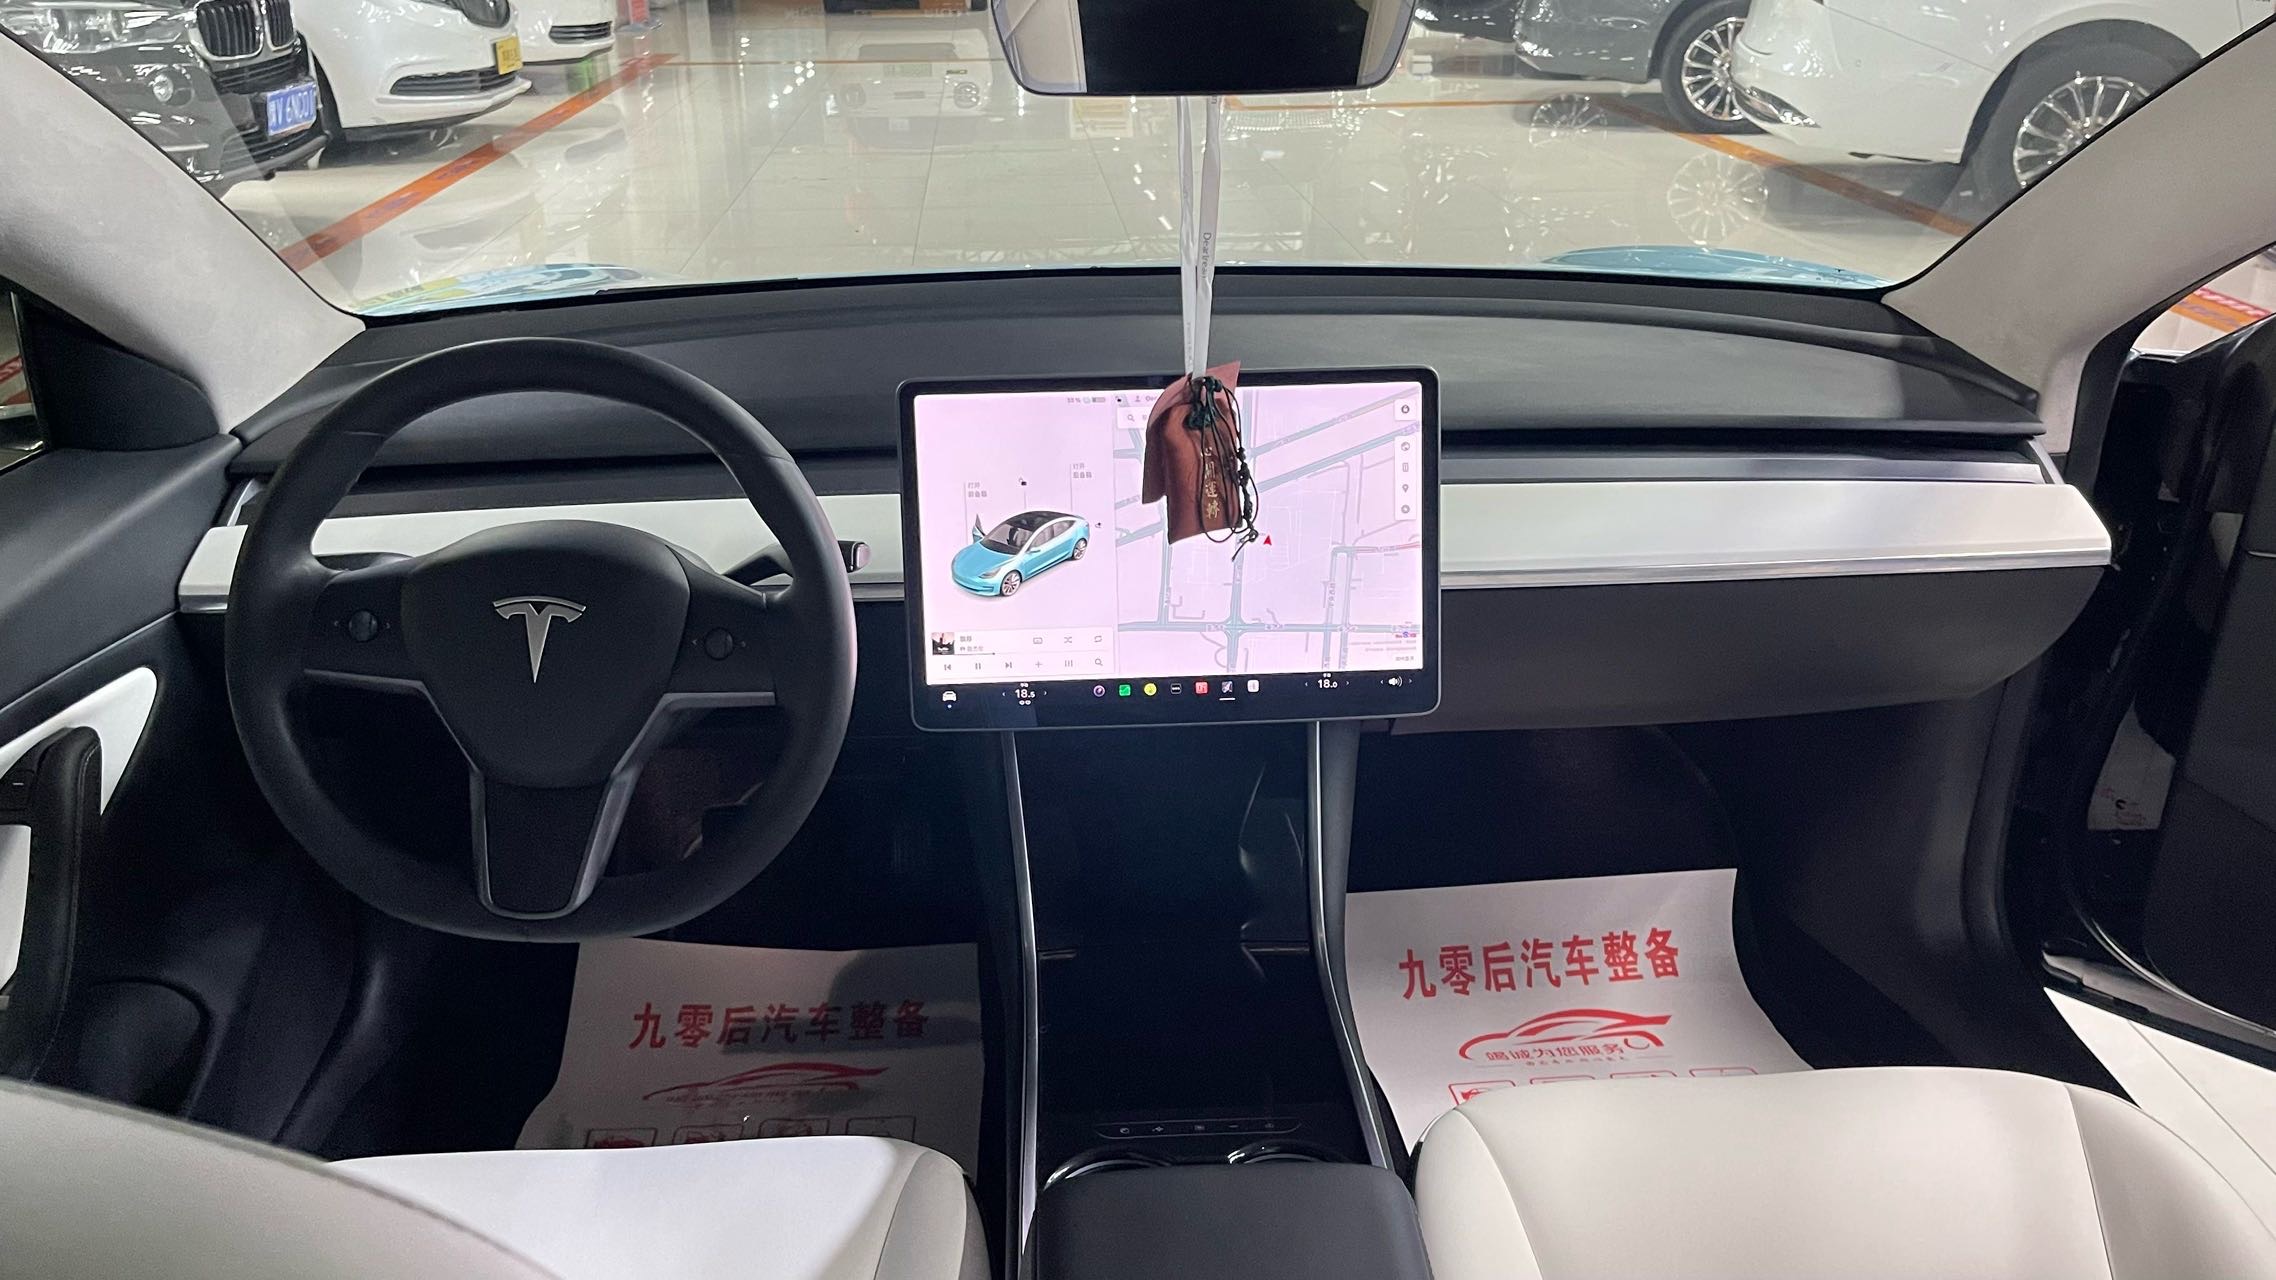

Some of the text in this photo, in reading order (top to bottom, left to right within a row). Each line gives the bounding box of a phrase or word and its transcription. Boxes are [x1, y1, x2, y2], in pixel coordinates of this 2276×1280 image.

[1015, 689, 1036, 698] 18.5
[1318, 678, 1338, 688] 18.0
[1399, 927, 1680, 1000] 九零后汽车整备
[628, 1001, 931, 1049] 九零后汽车整备
